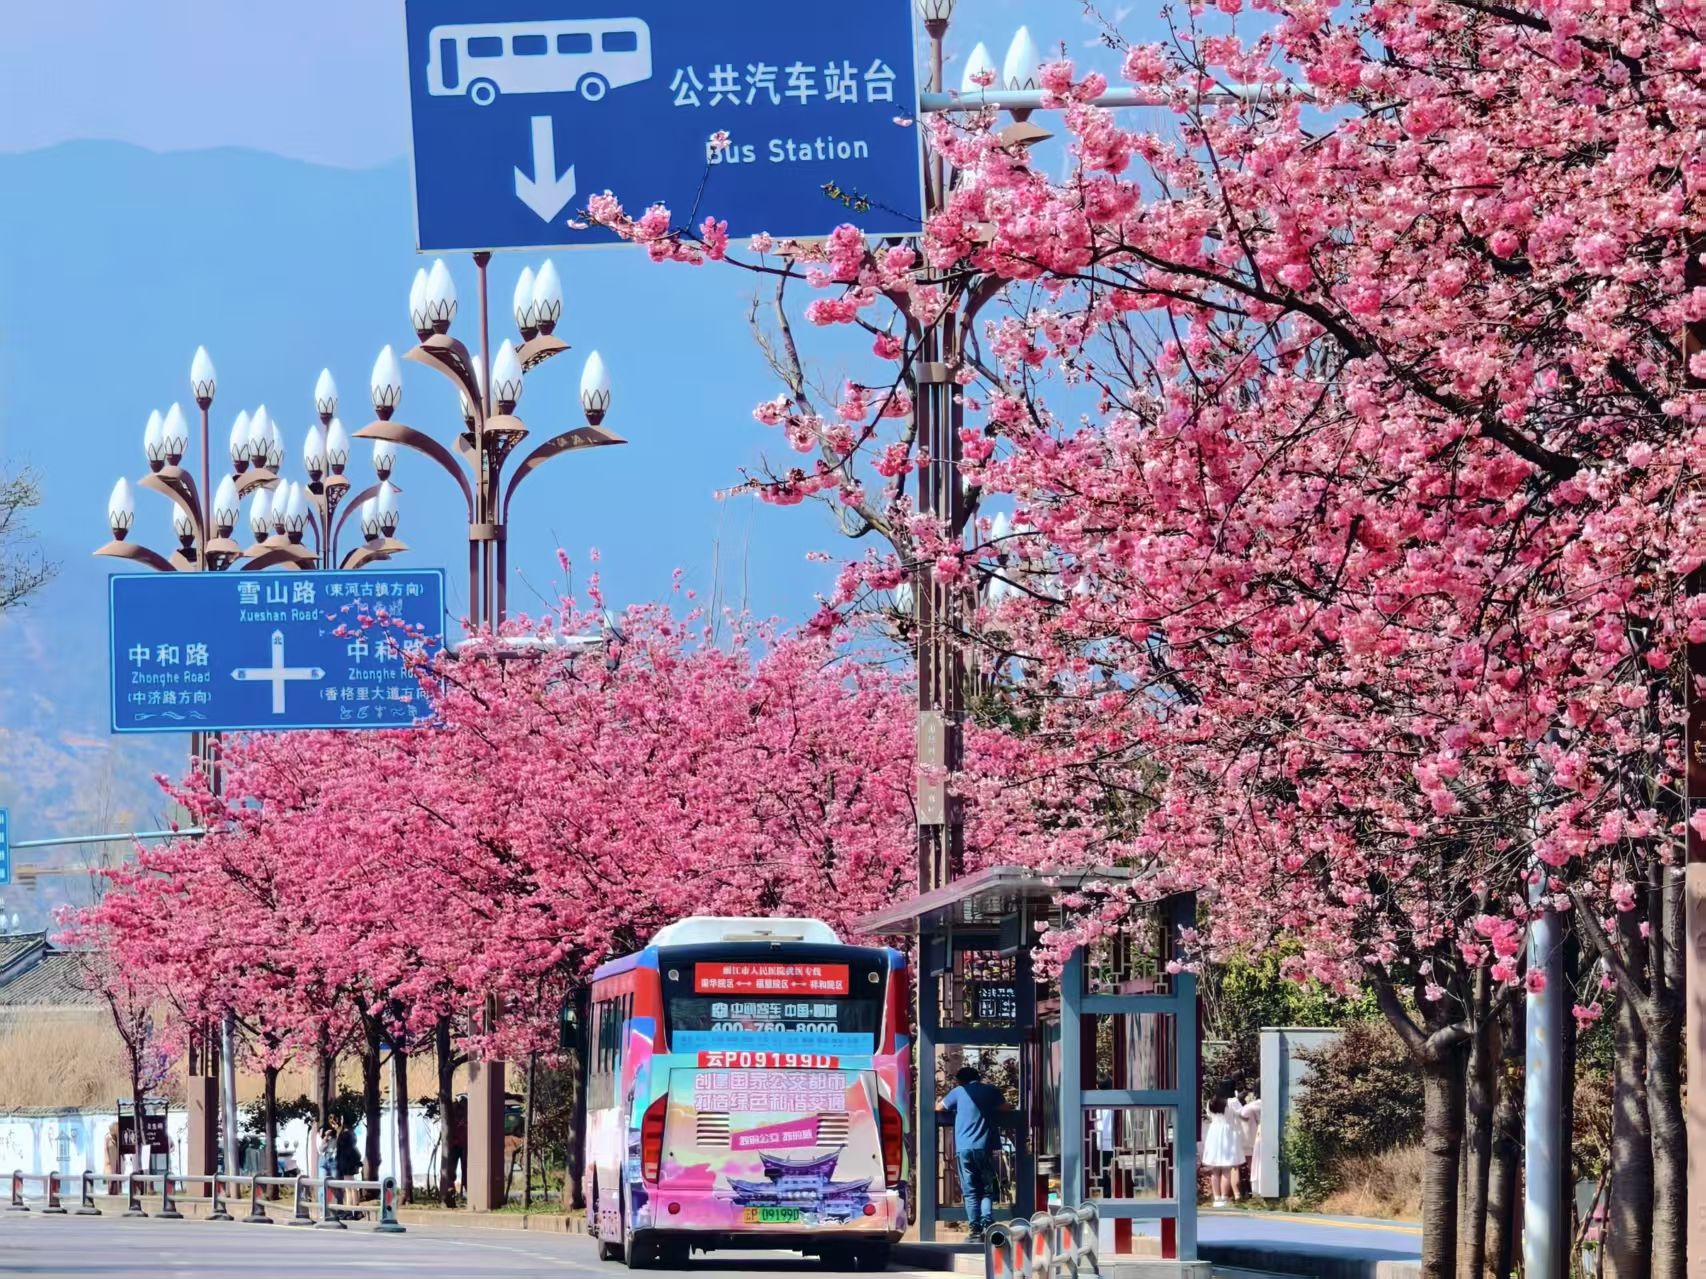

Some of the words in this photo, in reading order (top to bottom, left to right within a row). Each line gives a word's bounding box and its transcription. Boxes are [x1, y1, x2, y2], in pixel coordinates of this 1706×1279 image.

[669, 58, 897, 108] 公共汽车站台
[706, 139, 756, 165] Bus
[768, 136, 869, 163] Station
[237, 580, 317, 605] 雪山路
[240, 610, 287, 622] Xueshan
[292, 609, 319, 621] Road
[128, 642, 209, 667] 中和路
[131, 671, 180, 687] Zhonghe
[184, 671, 210, 683] Road
[348, 667, 396, 683] Zhonghe
[711, 1022, 838, 1033] 400-760-8000
[706, 1051, 831, 1068] 云P09199D
